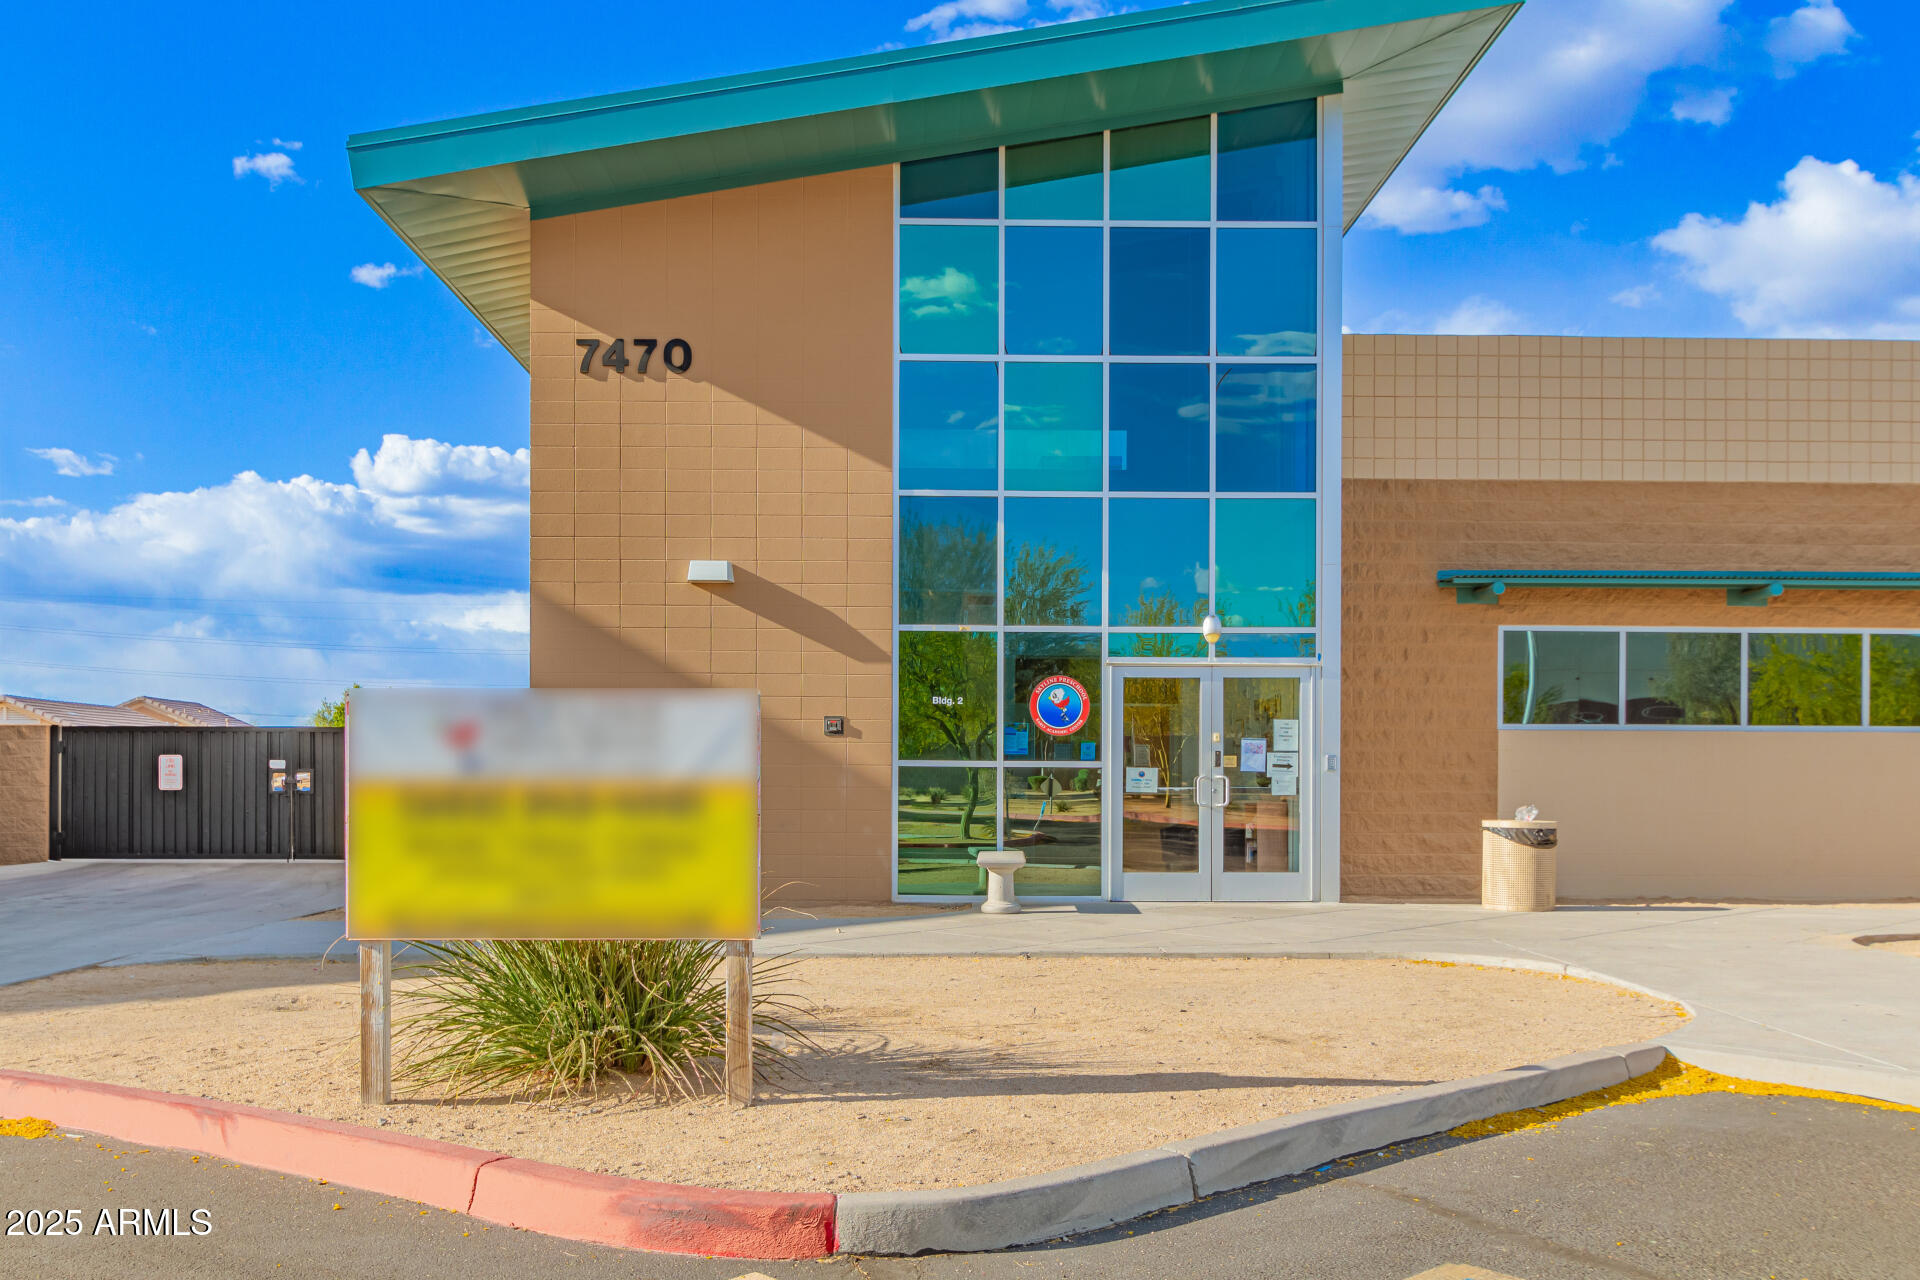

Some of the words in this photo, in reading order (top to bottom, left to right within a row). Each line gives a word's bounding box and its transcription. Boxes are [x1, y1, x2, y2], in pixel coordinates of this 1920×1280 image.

[576, 338, 692, 374] 7470
[932, 696, 955, 706] Bldg.
[957, 696, 964, 705] 2
[1035, 677, 1057, 694] SKYLINE
[1058, 677, 1087, 701] PRESCHOOL
